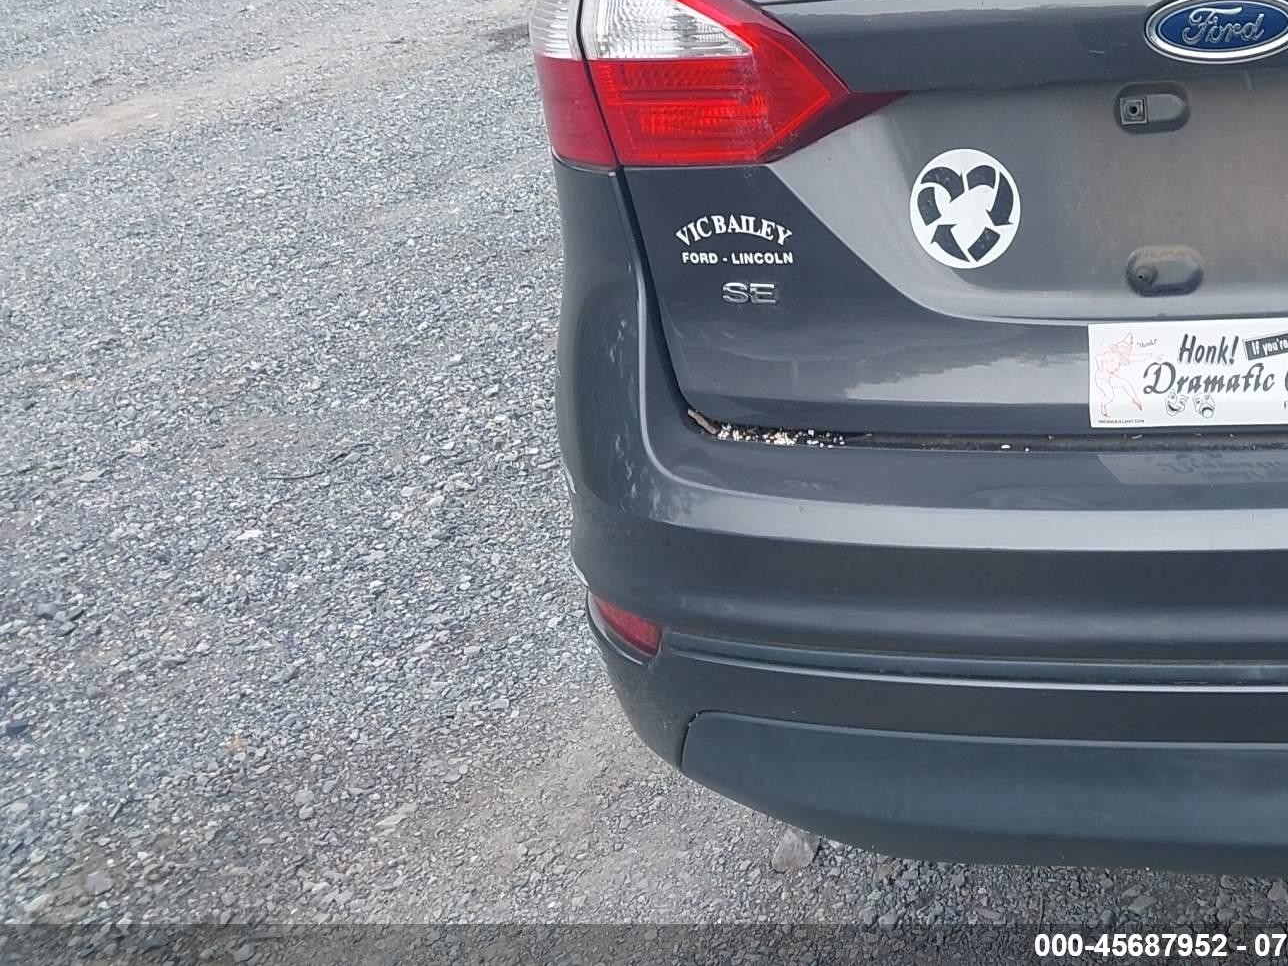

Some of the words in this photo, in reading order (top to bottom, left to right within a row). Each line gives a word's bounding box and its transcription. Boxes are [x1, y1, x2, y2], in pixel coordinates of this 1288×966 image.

[1182, 7, 1265, 44] Ford
[675, 216, 712, 246] VIC
[711, 214, 793, 246] BAILEY
[682, 252, 718, 264] FORD
[731, 252, 793, 264] LINCOLN
[722, 282, 776, 304] SE
[1178, 333, 1239, 365] Honk!
[1251, 340, 1260, 355] If
[1143, 361, 1275, 394] Dramatic
